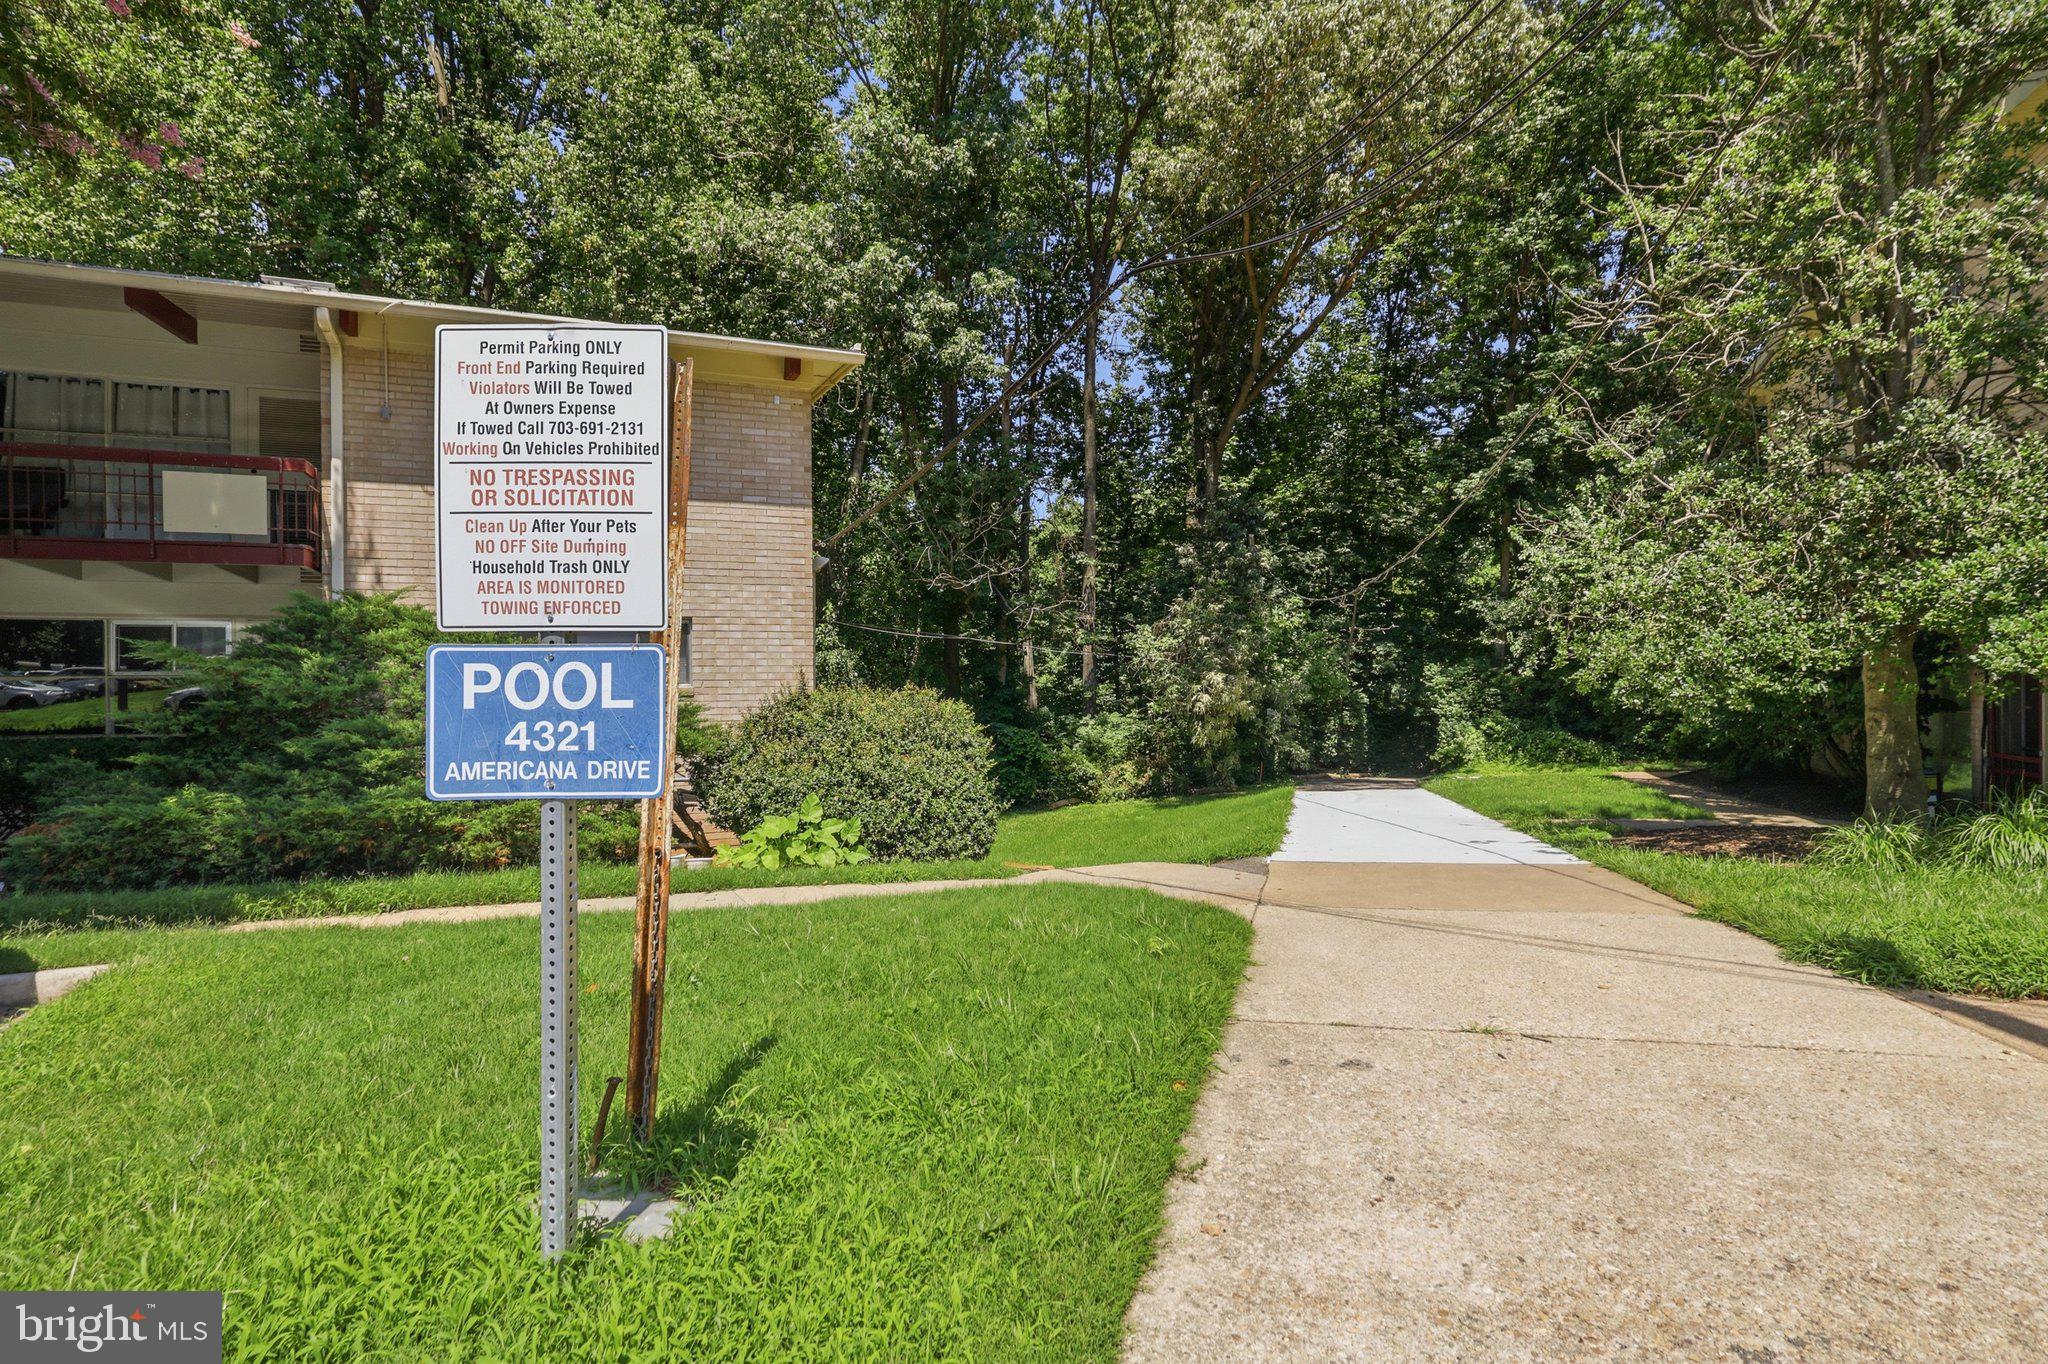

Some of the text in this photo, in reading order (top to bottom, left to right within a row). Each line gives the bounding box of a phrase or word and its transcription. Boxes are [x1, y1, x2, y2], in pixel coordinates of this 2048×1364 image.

[480, 341, 622, 356] Permit Parking ONLY
[457, 361, 645, 376] Front End Parking Required
[469, 381, 632, 395] Violators Will Be Towed
[485, 402, 615, 417] At Owners Expense
[457, 422, 644, 435] If Towed Call 703-691-2131
[443, 442, 659, 458] Working On Vehicles Prohibited
[469, 469, 635, 487] NO TRESPASSING
[471, 489, 634, 506] OR SOLICITATION
[465, 519, 637, 535] Clean Up After Your Pets
[475, 540, 626, 555] NO OFF Site Dumping
[472, 560, 630, 574] Household Trash ONLY
[477, 580, 625, 594] AREA IS MONITORED
[481, 601, 621, 615] TOWING ENFORCED
[464, 662, 633, 710] POOL
[505, 721, 595, 751] 4321
[445, 761, 650, 781] AMERICANA DRIVE
